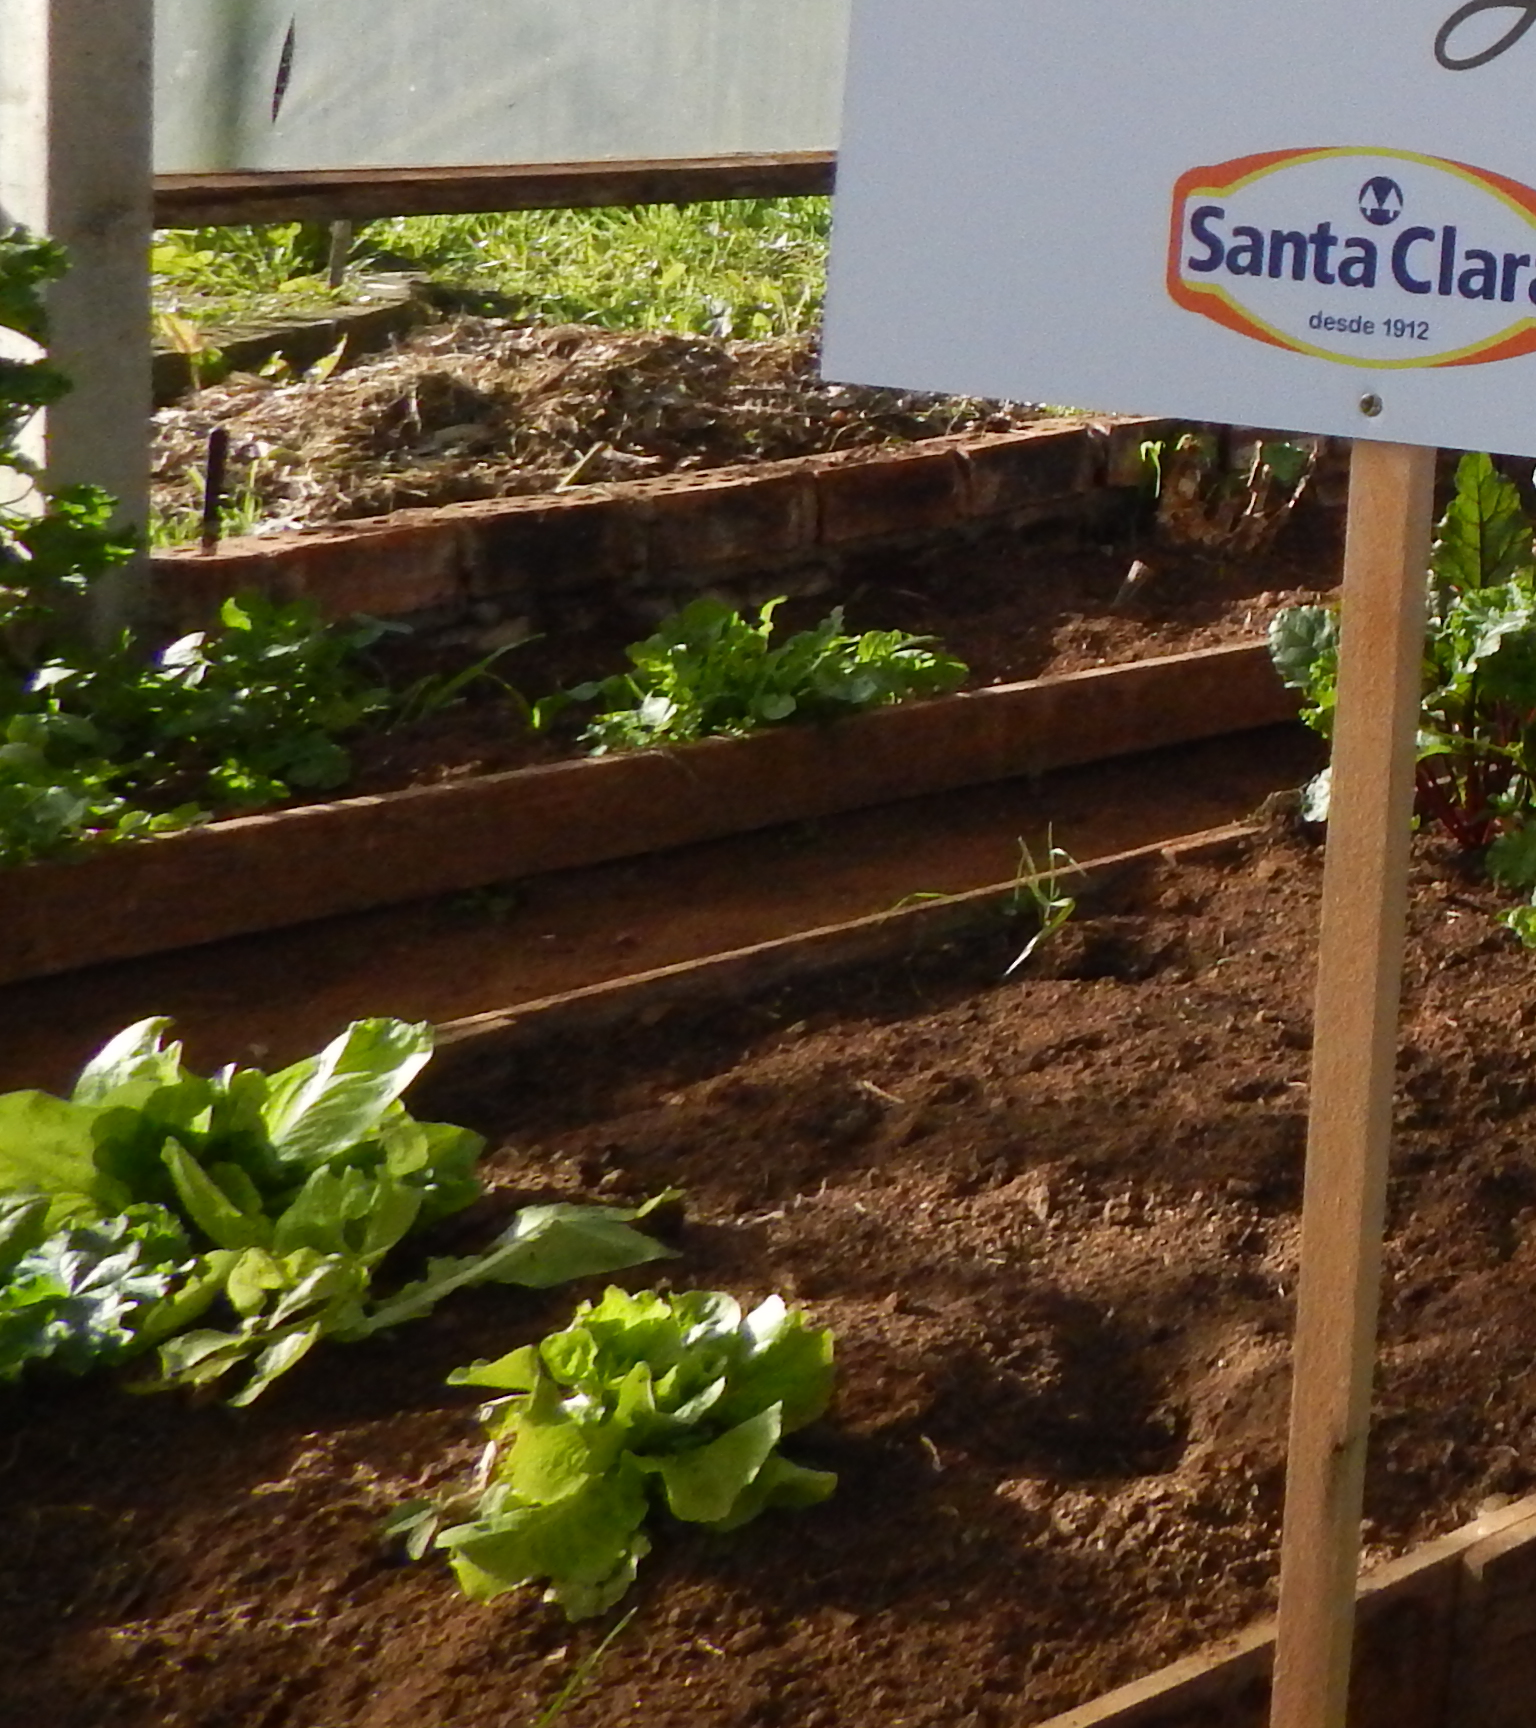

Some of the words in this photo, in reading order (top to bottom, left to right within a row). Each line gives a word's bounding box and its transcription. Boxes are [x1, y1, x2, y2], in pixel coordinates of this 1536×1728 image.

[1186, 204, 1379, 289] Santa
[1308, 310, 1375, 336] desde
[1383, 317, 1430, 342] 1912
